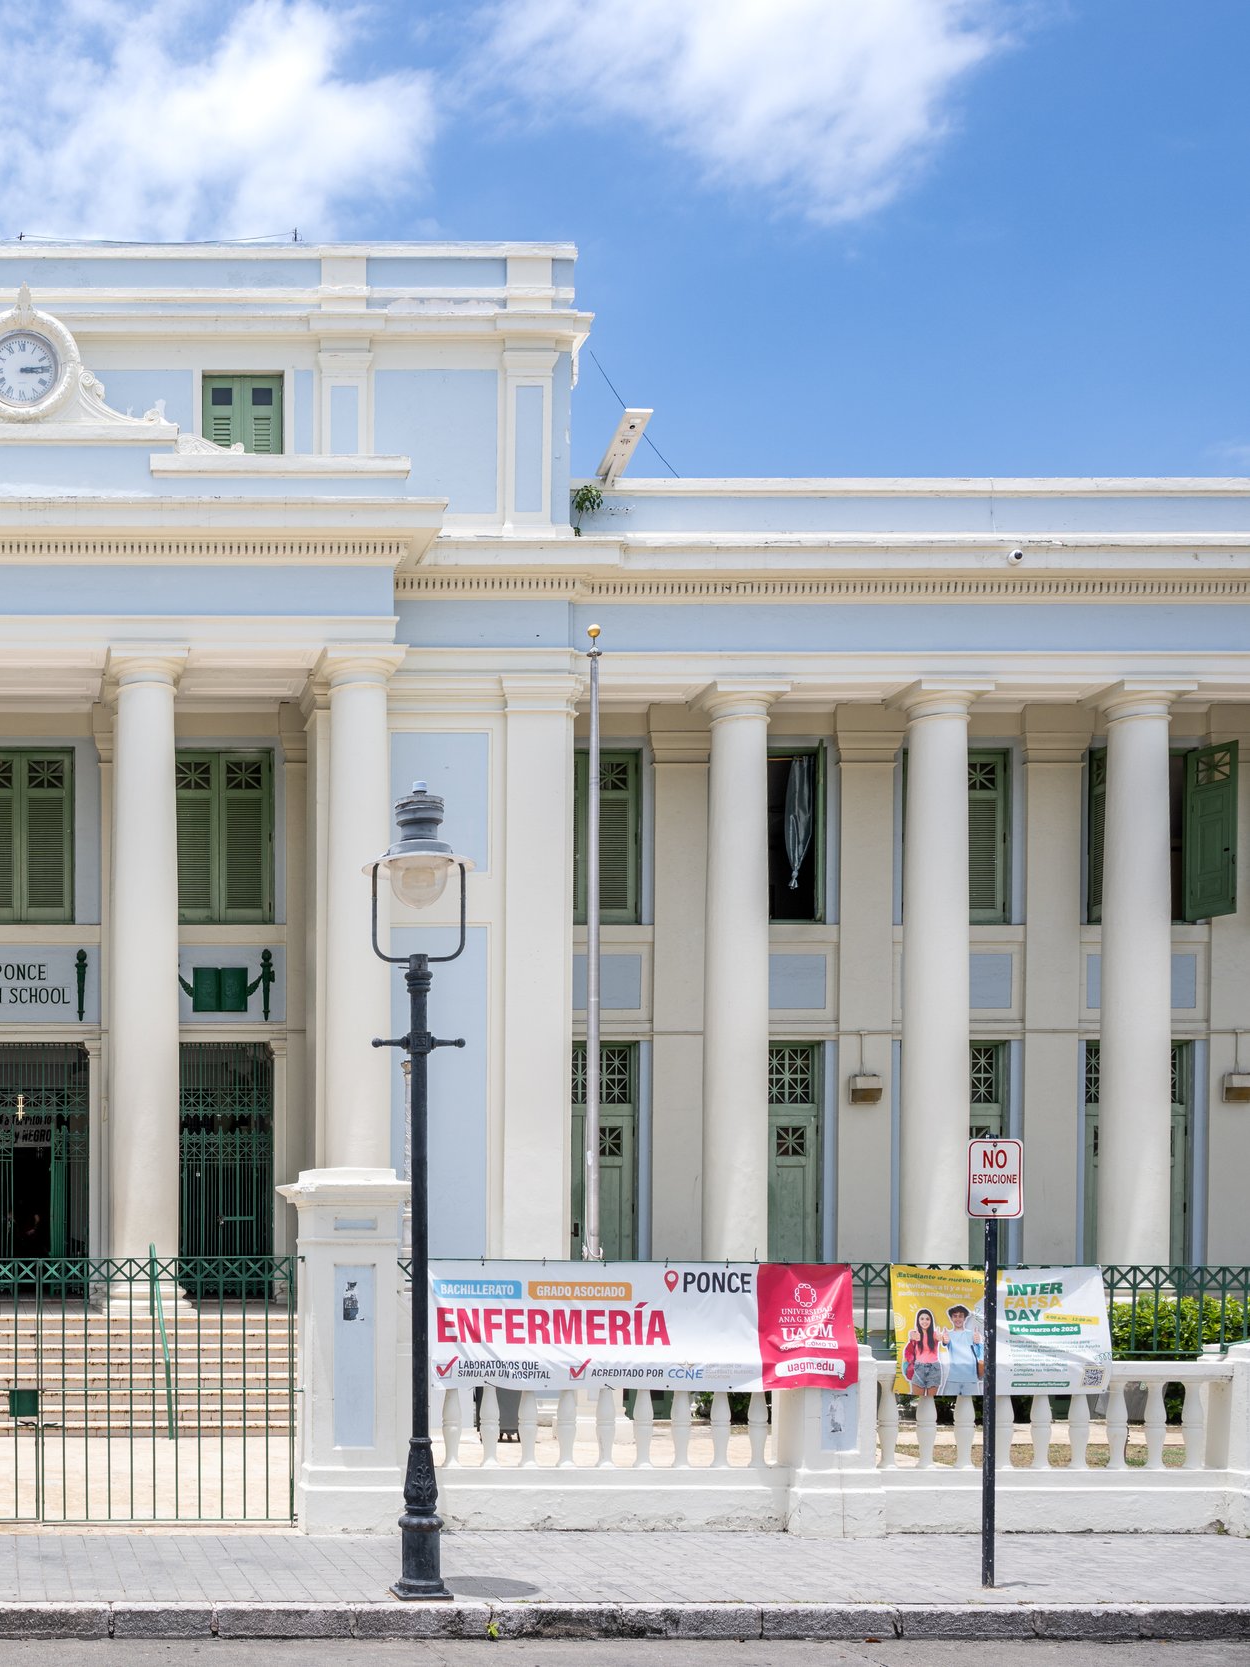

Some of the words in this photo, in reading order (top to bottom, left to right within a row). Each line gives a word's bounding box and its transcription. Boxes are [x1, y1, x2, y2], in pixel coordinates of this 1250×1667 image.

[8, 987, 71, 1004] SCHOOL
[982, 1149, 1008, 1169] NO
[972, 1174, 1018, 1184] ESTACIONE
[683, 1272, 753, 1294] PONCE
[1006, 1282, 1063, 1296] INTER
[440, 1284, 514, 1296] BACHILLERATO
[536, 1285, 572, 1297] GRADO
[573, 1286, 626, 1297] ASOCIADO
[1003, 1295, 1063, 1309] FAFSA
[781, 1305, 833, 1315] UNIVERSIDAD
[1004, 1309, 1041, 1321] DAY
[436, 1301, 670, 1346] ENFERMERÍA
[778, 1316, 796, 1324] ANA
[781, 1323, 835, 1342] UAGM
[521, 1361, 539, 1371] QUE
[787, 1360, 835, 1373] uagm.edu
[457, 1369, 496, 1378] SIMULAN
[498, 1370, 510, 1379] UN
[512, 1370, 551, 1379] HOSPITAL
[591, 1368, 644, 1378] ACREDITADO
[646, 1368, 664, 1378] POR
[667, 1368, 704, 1380] CCNE
